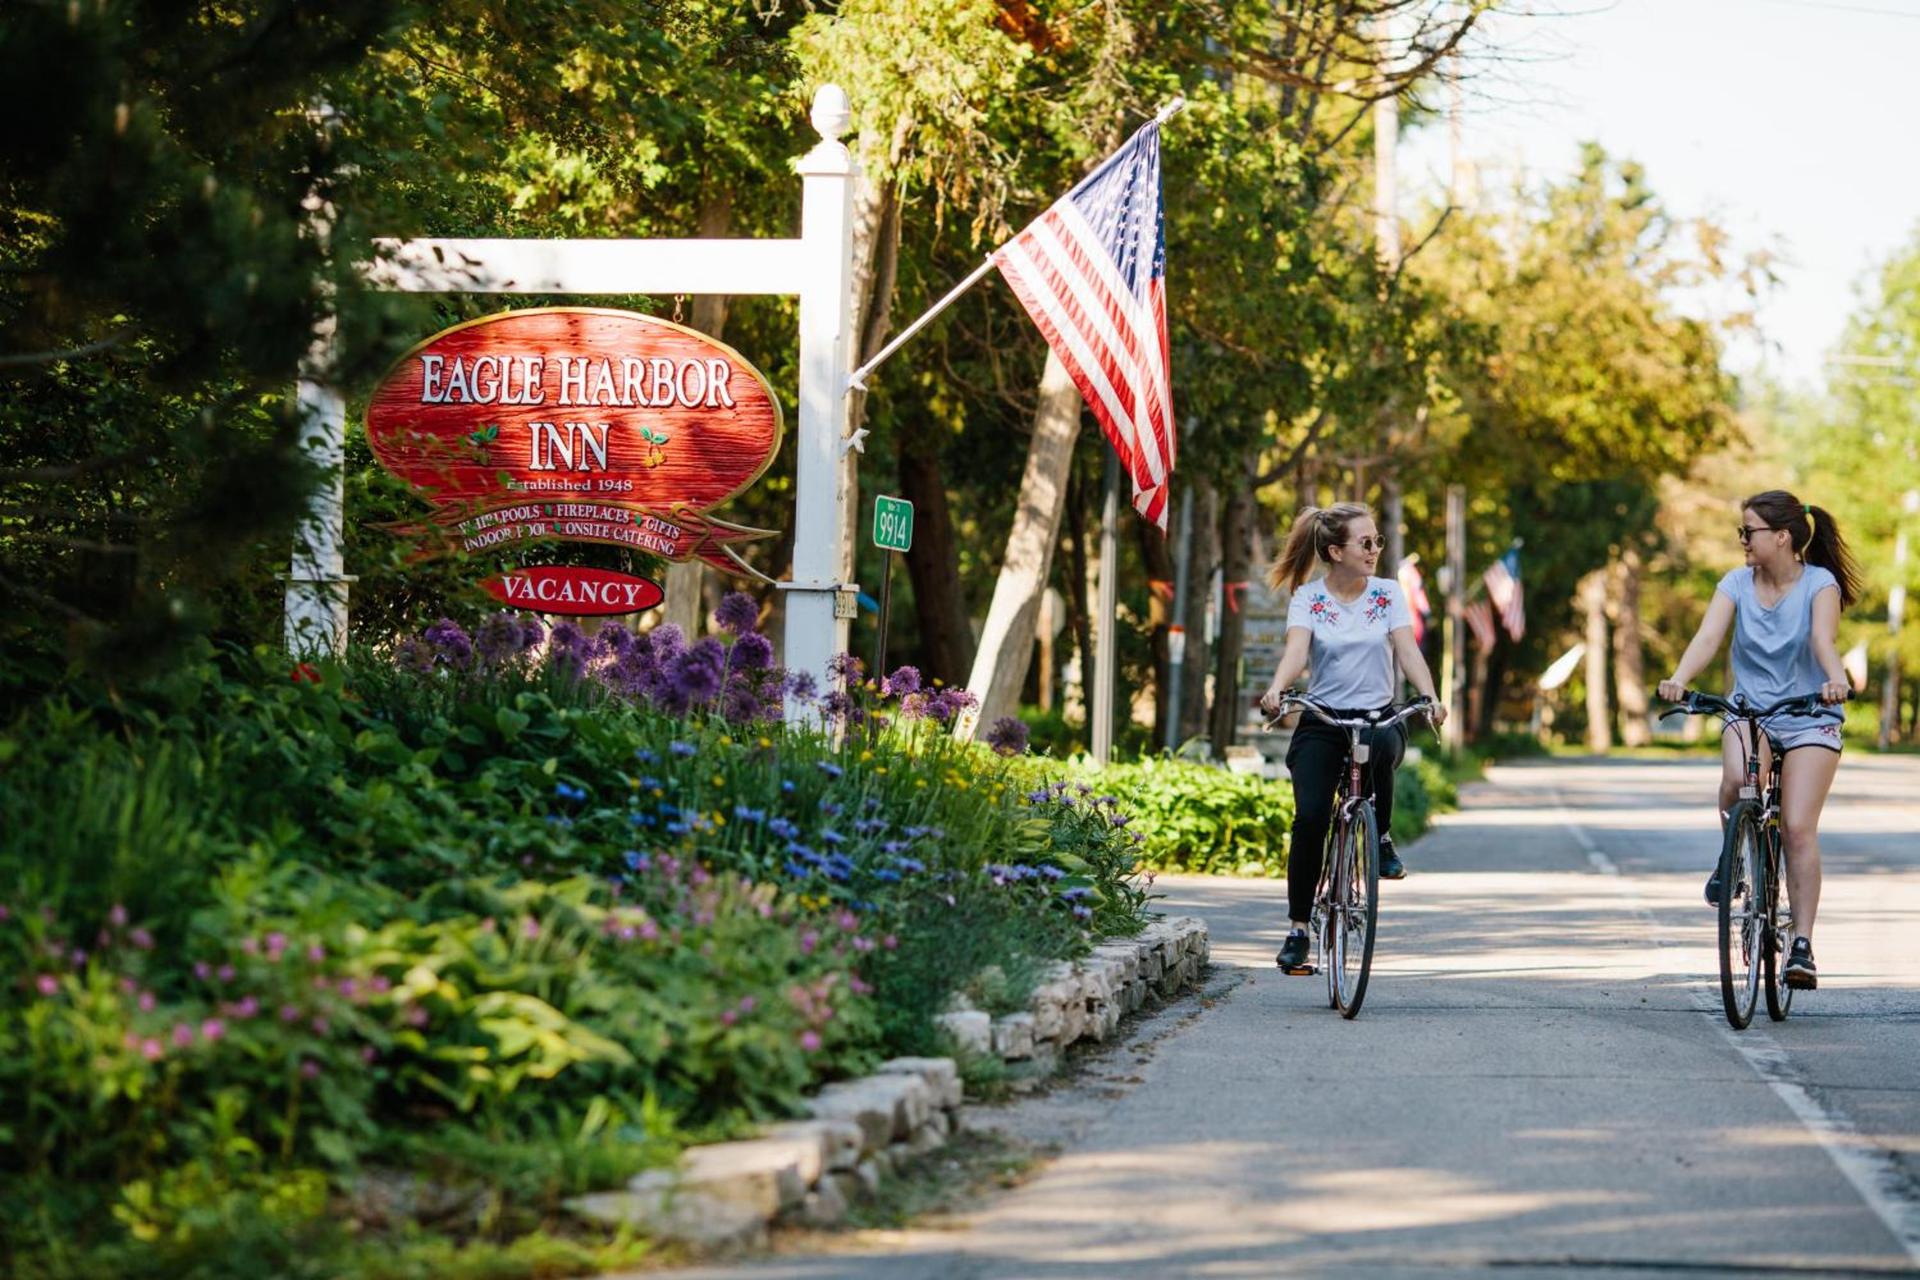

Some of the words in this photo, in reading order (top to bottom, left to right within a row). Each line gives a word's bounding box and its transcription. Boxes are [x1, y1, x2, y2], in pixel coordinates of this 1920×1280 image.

[421, 355, 544, 404] EAGLE
[558, 357, 735, 407] HARBOR
[528, 422, 610, 471] INN
[507, 478, 592, 491] Etablished
[598, 479, 633, 492] 1948
[458, 504, 540, 534] WIRLPOOLS
[556, 503, 630, 524] FIREPLACES
[645, 516, 681, 540] GIFTS
[463, 528, 513, 552] INDOOR
[565, 521, 611, 538] ONSITE
[613, 526, 675, 556] CATERING
[880, 511, 906, 546] 9914
[502, 575, 643, 606] VACANCY
